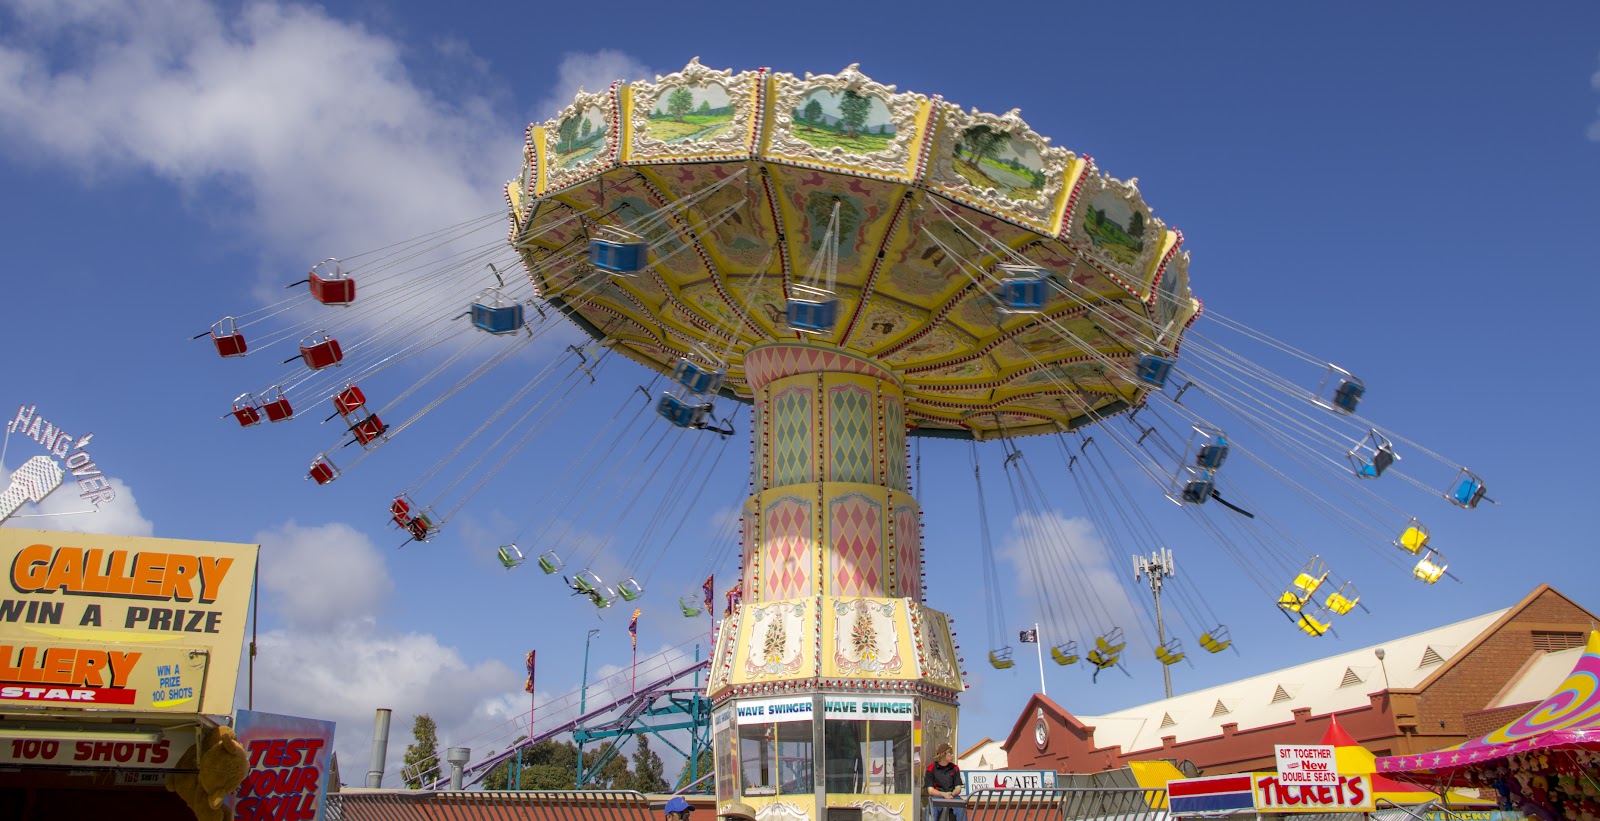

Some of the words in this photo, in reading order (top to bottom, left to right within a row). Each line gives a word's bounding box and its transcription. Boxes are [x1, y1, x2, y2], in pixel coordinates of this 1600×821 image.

[10, 544, 234, 604] GALLERY
[0, 600, 64, 625] WIN
[79, 604, 102, 627] A
[125, 607, 222, 633] PRIZE
[157, 665, 171, 676] WIN
[174, 664, 180, 675] A
[160, 676, 181, 688] PRIZE
[1, 687, 95, 700] STAR
[152, 691, 165, 702] 100
[169, 687, 193, 699] SHOTS
[737, 705, 765, 717] WAVE
[768, 703, 812, 714] SWINGER
[825, 701, 857, 714] WAVE
[862, 701, 912, 714] SWINGER
[12, 740, 59, 760] 100
[74, 740, 170, 764] SHOTS
[248, 738, 324, 768] TEST
[1280, 749, 1291, 758] SIT
[1293, 749, 1331, 758] TOGETHER
[1301, 760, 1327, 770] New
[236, 766, 319, 798] YOUR
[973, 775, 987, 783] RED
[1282, 772, 1311, 782] DOUBLE
[1314, 772, 1336, 782] SEATS
[1258, 776, 1364, 806] TICKETS
[234, 794, 316, 821] SKILL
